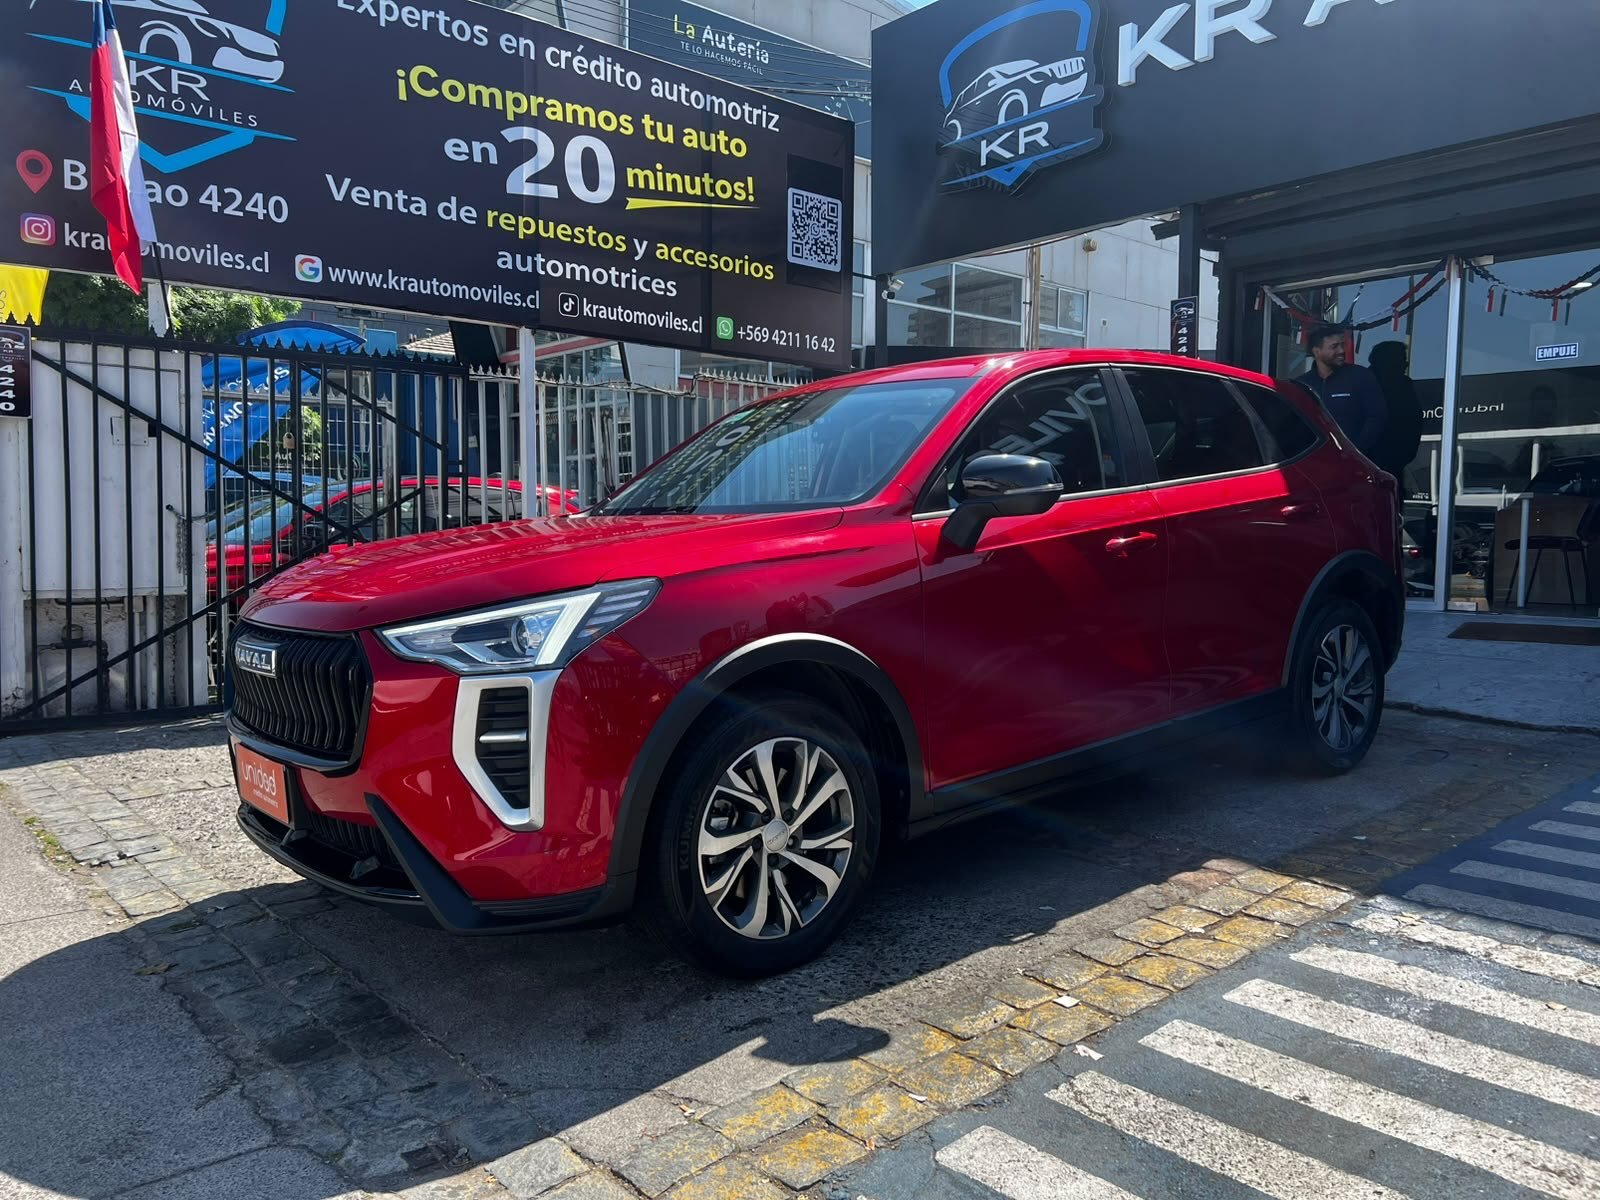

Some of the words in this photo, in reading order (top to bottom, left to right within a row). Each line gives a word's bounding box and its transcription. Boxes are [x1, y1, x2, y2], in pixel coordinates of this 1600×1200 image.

[674, 14, 696, 39] La
[702, 25, 769, 64] Autería
[681, 41, 690, 52] TE
[692, 45, 703, 55] LO
[704, 49, 741, 68] HACEMOS
[1118, 0, 1277, 87] KR
[129, 60, 211, 101] KR
[500, 33, 536, 61] en
[545, 44, 642, 91] crédito
[651, 77, 780, 132] automotriz
[397, 65, 634, 136] ¡Compramos
[642, 114, 674, 143] tu
[682, 126, 747, 158] auto
[444, 137, 498, 164] en
[500, 126, 616, 204] 20
[626, 163, 756, 202] minutos!
[980, 121, 1050, 166] KR
[199, 184, 289, 223] 4240
[325, 173, 427, 216] Venta
[437, 195, 478, 225] de
[487, 209, 627, 252] repuestos
[633, 238, 648, 261] y
[656, 242, 775, 281] accesorios
[328, 266, 540, 309] www.krautomoviles.cl
[496, 250, 678, 297] automotrices
[583, 297, 703, 334] krautomoviles.cl
[737, 325, 769, 343] +569
[772, 329, 801, 348] 4211
[805, 334, 819, 350] 16
[821, 336, 836, 352] 42
[1538, 345, 1576, 358] EMPUJE
